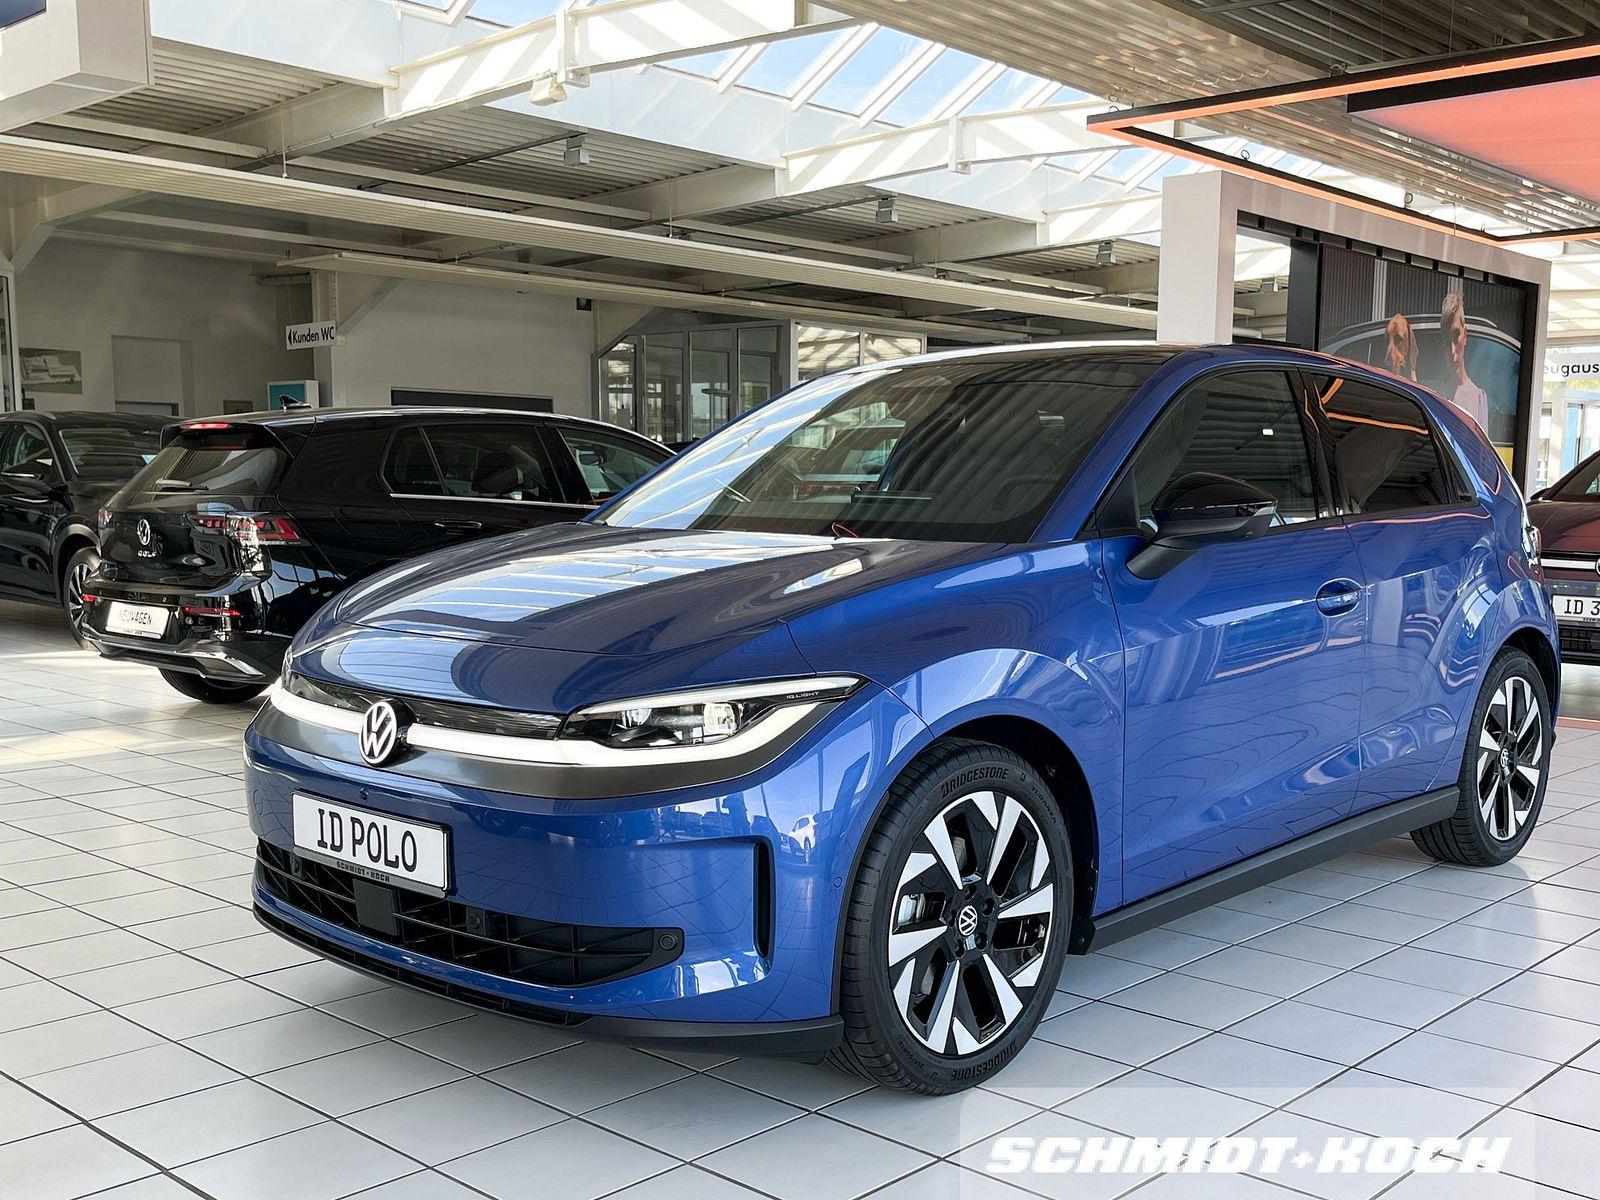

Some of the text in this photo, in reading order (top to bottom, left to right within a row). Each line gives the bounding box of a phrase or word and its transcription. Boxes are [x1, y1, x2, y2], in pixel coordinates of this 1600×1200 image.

[293, 326, 335, 344] Kunden WC
[1564, 599, 1584, 615] ID
[940, 766, 1009, 799] BRIDGESTONE
[317, 808, 418, 873] ID POLO
